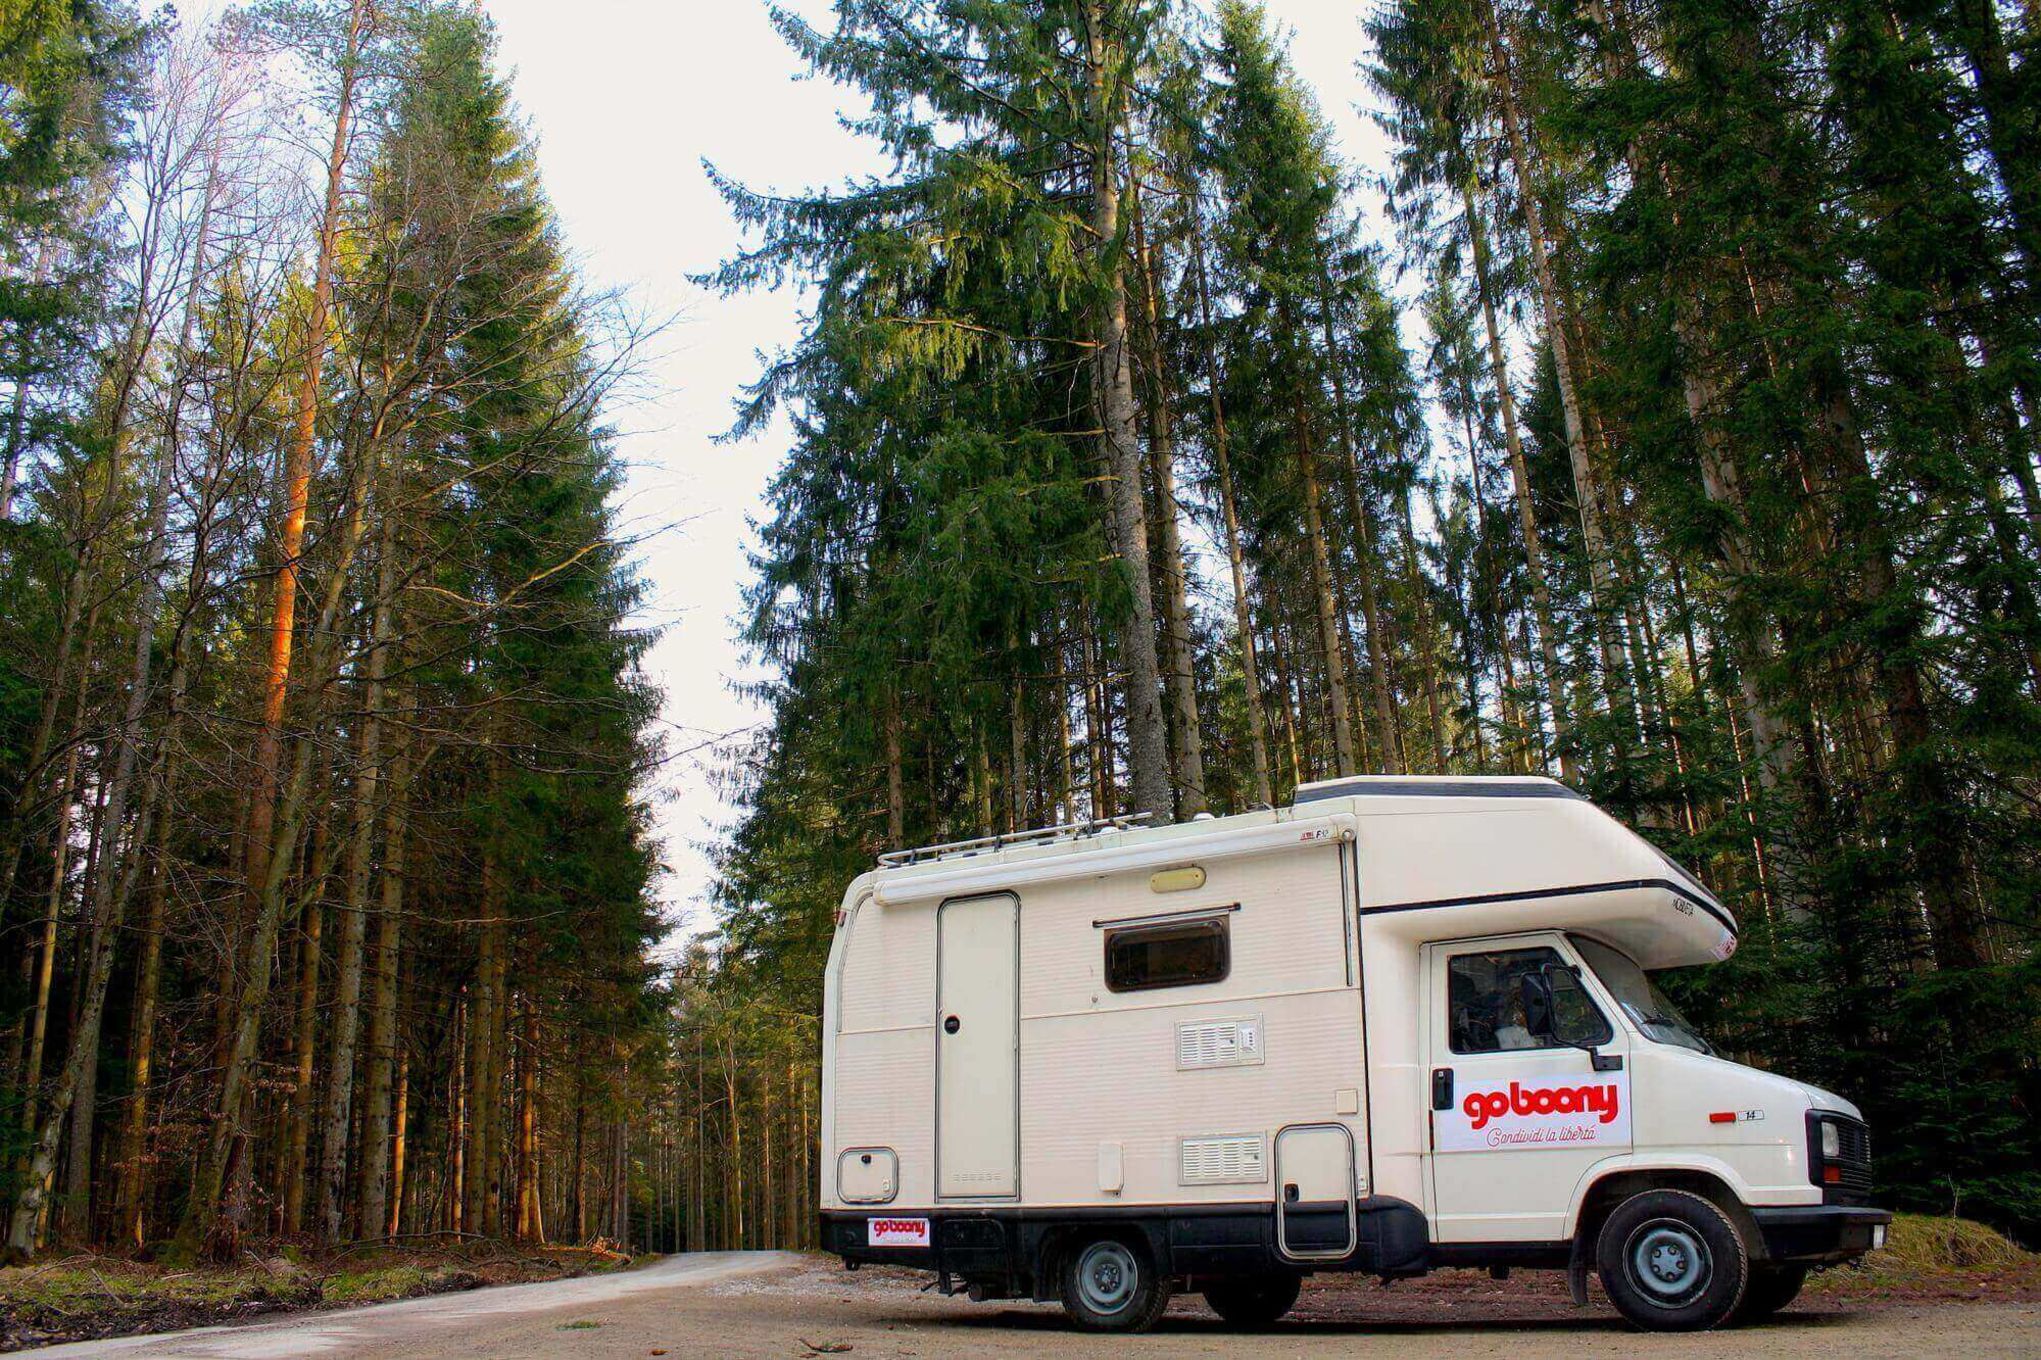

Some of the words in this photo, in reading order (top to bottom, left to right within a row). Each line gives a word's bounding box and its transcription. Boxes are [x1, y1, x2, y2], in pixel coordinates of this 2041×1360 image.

[1463, 1082, 1618, 1130] goboony
[1487, 1127, 1543, 1147] Condividi
[1546, 1127, 1556, 1142] la
[874, 1220, 926, 1238] goboony
